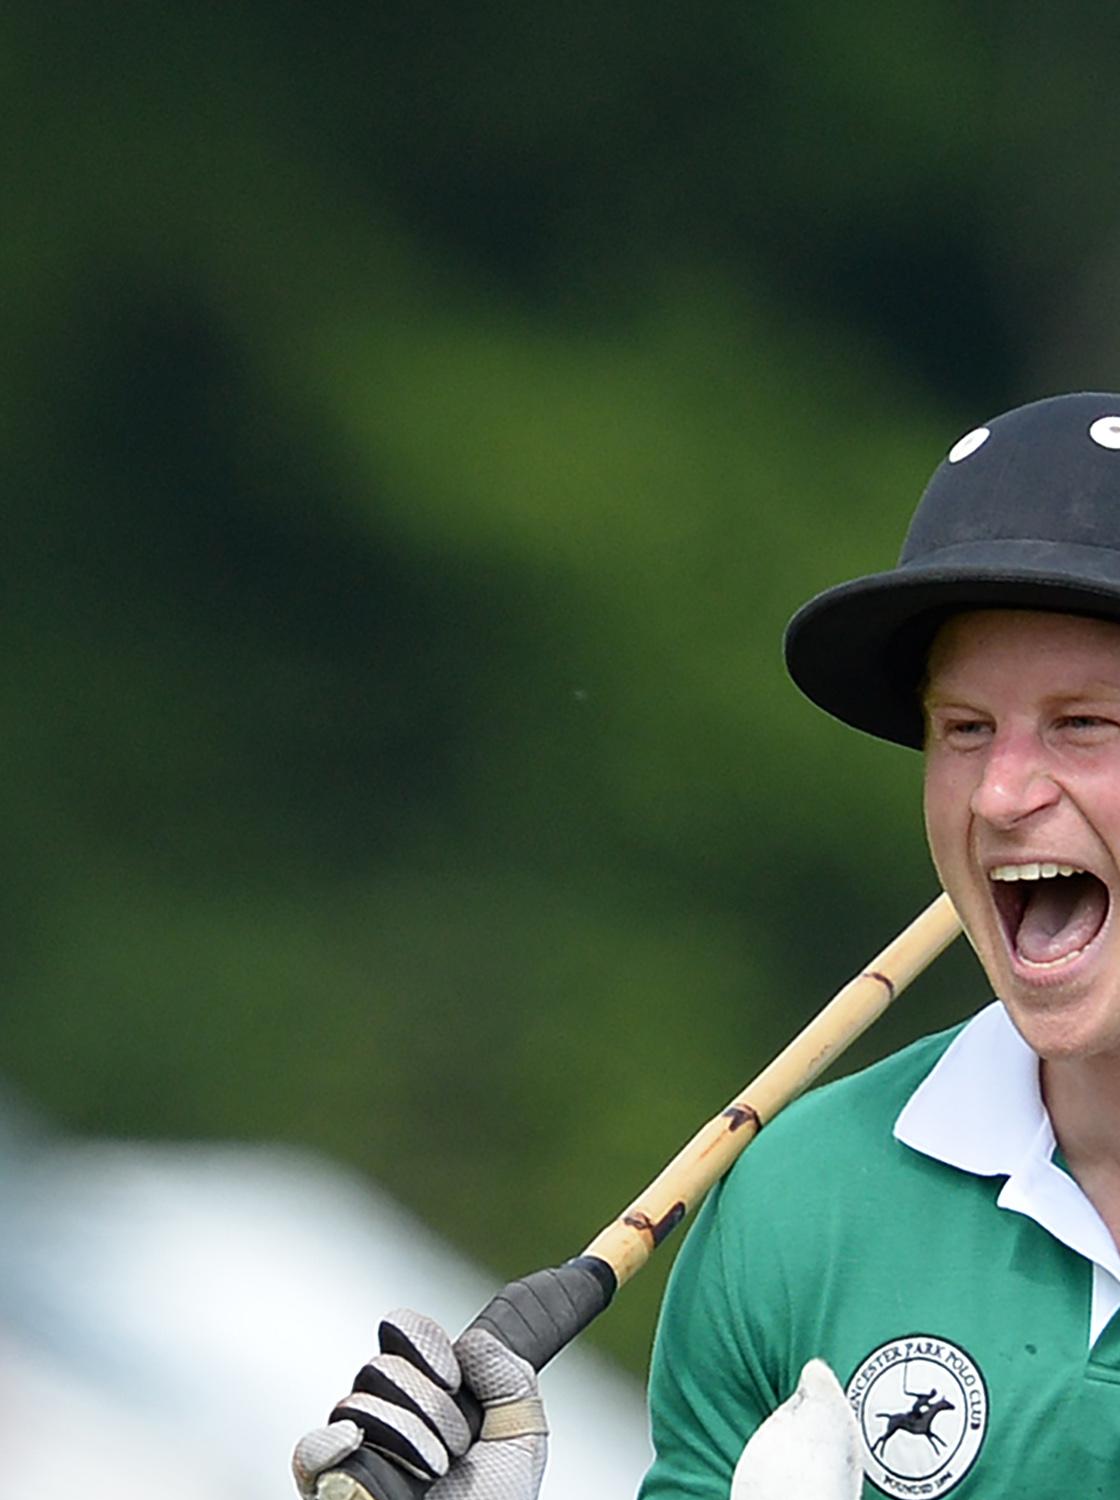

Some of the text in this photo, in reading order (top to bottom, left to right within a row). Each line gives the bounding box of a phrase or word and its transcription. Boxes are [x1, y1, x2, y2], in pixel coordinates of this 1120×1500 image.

[904, 1342, 946, 1360] PARK
[945, 1351, 976, 1387] POLO
[969, 1389, 982, 1431] CLUB
